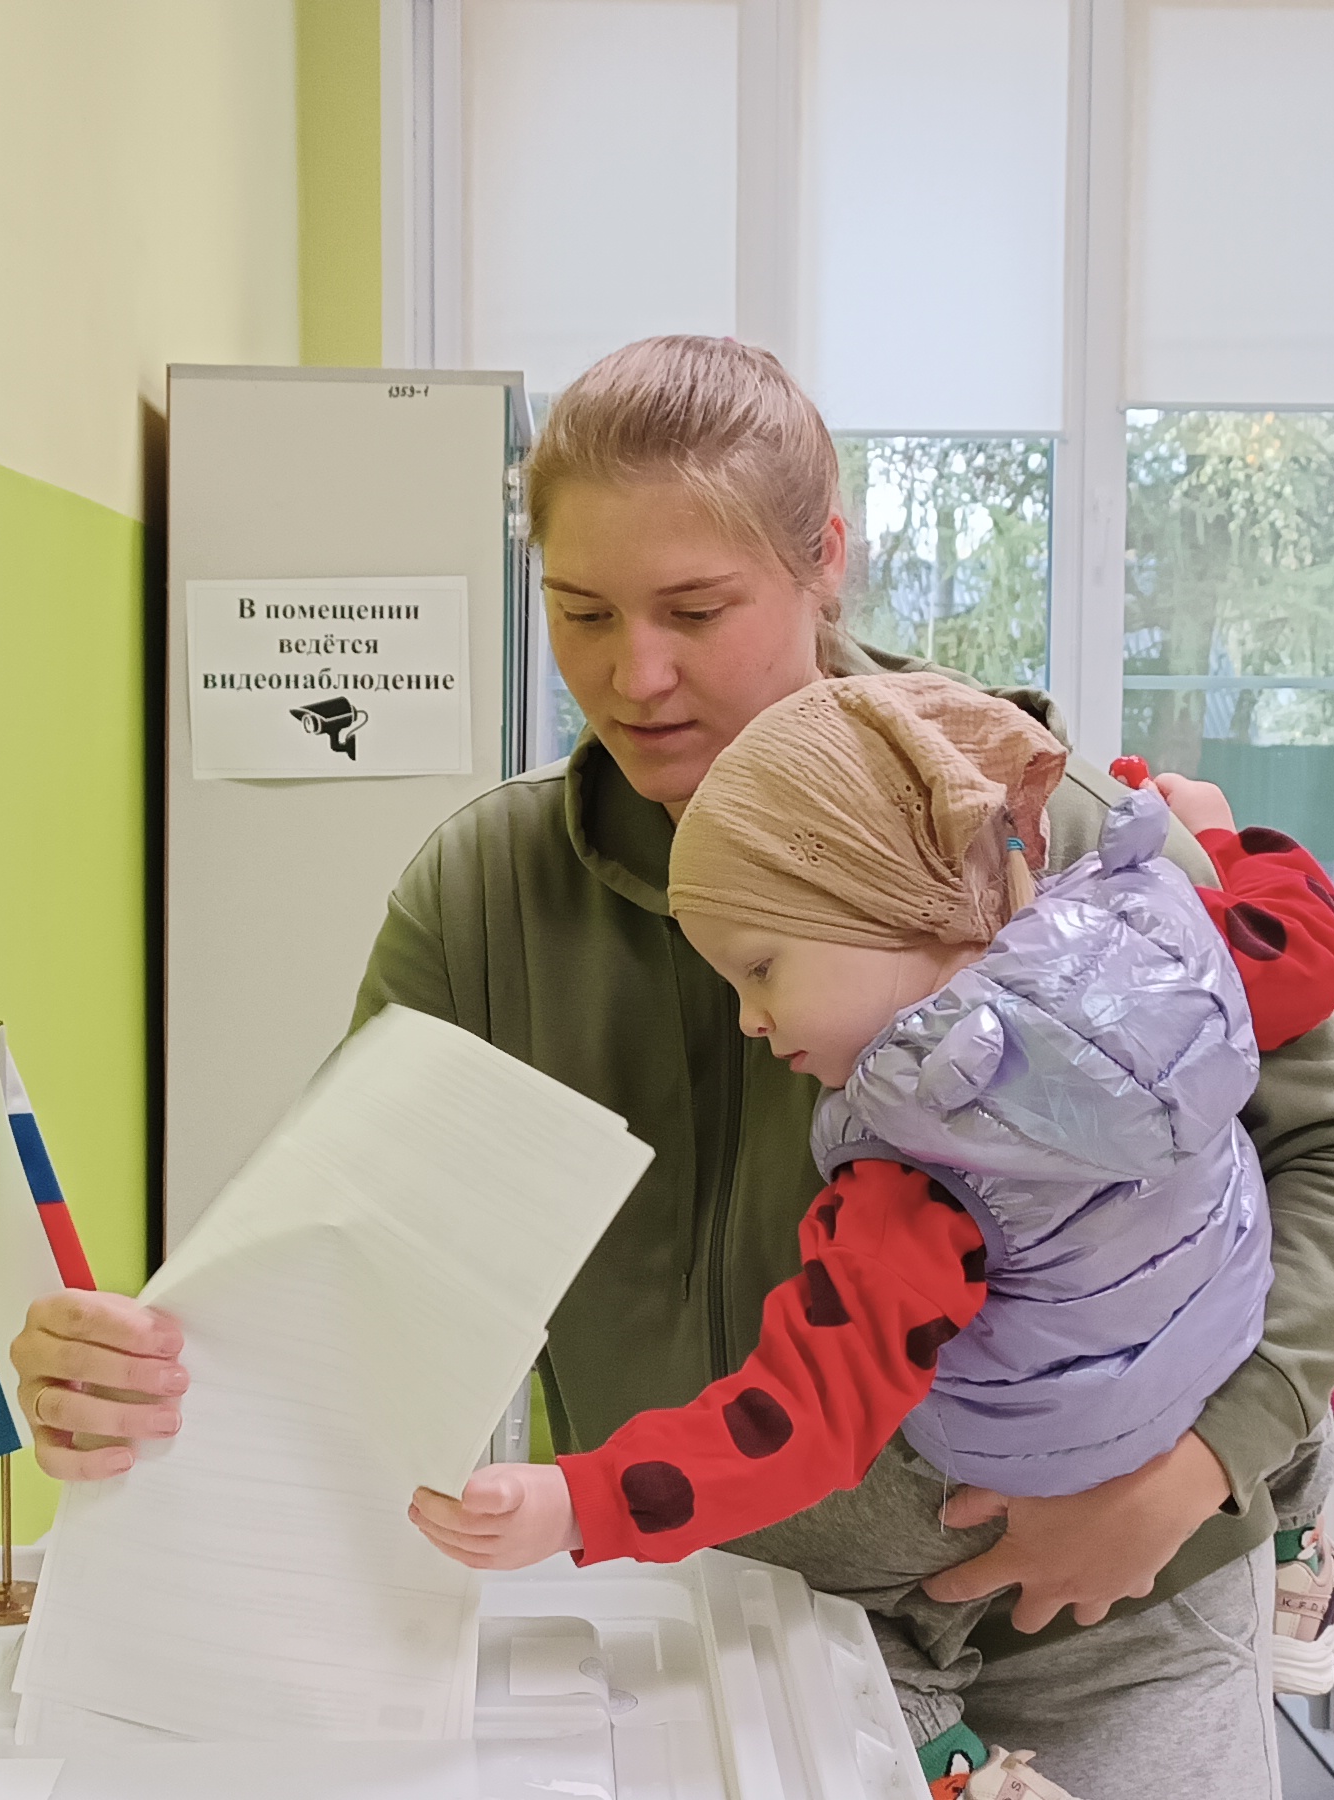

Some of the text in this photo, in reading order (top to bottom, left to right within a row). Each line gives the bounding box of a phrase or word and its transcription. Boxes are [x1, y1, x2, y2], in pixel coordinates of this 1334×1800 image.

[238, 598, 419, 621] В помещении
[278, 634, 379, 655] ведётся
[202, 668, 455, 692] видеонаблюдение
